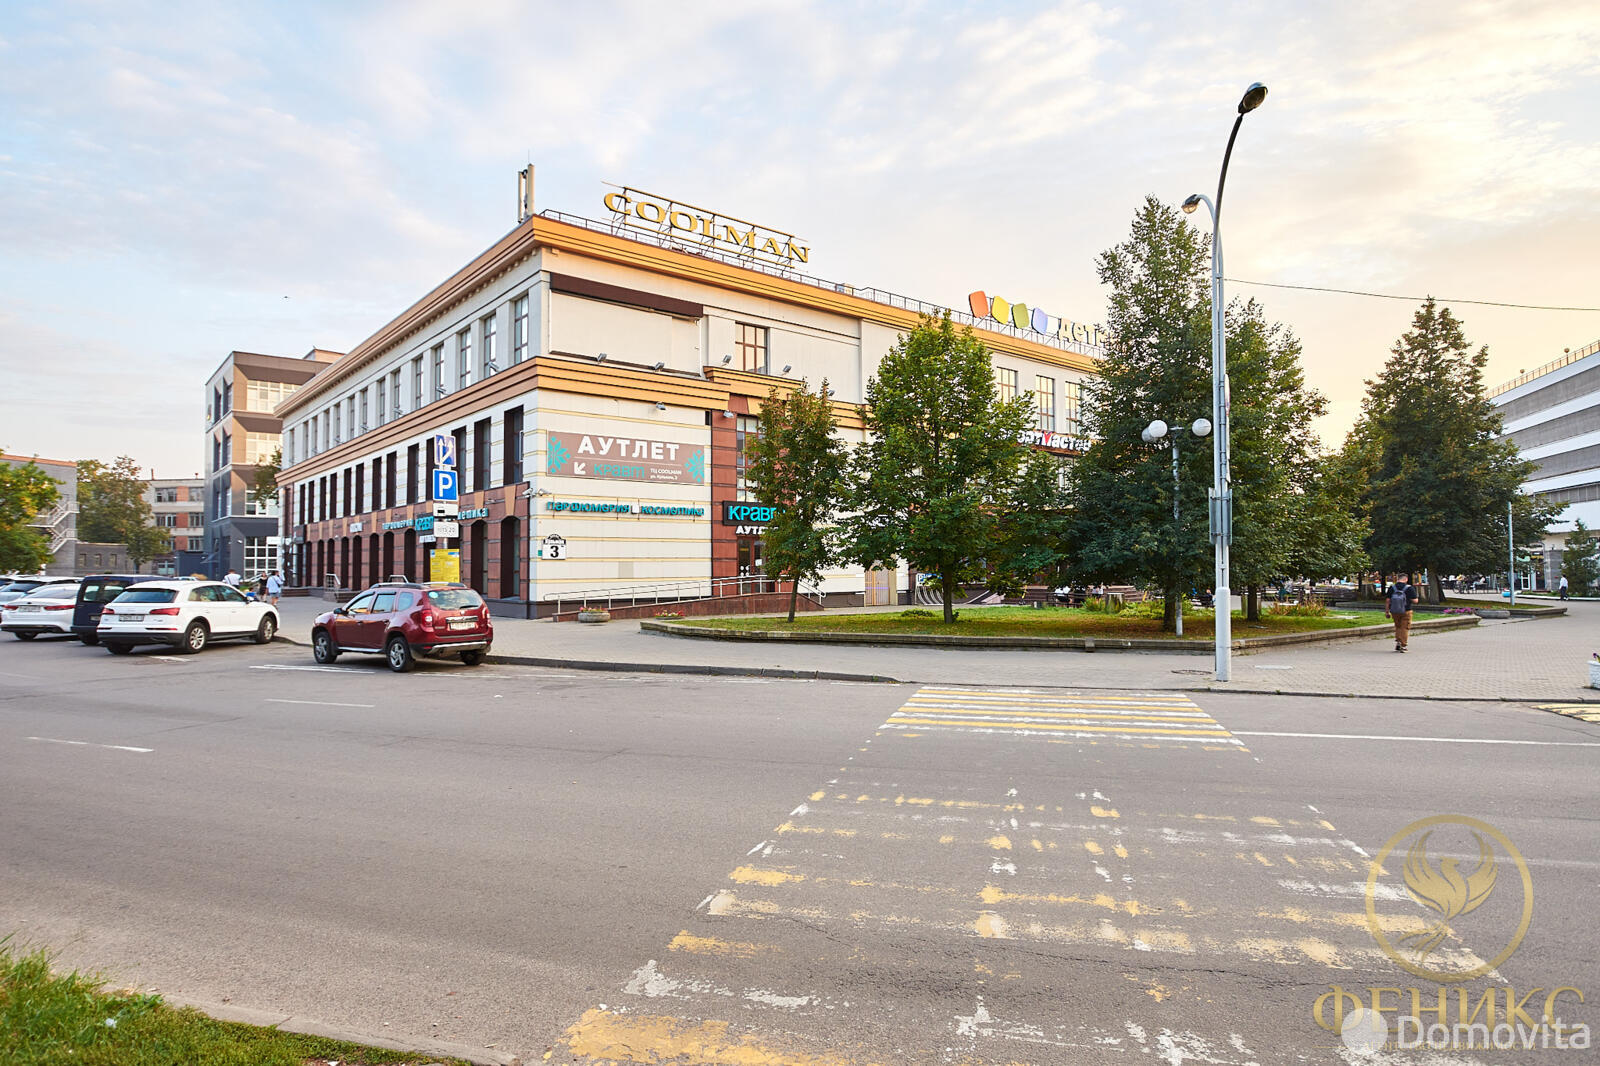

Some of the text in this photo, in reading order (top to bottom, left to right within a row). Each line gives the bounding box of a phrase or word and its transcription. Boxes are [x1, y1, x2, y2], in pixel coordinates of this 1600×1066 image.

[603, 192, 811, 264] COOLMAN
[577, 435, 680, 461] АУТЛЕТ
[438, 473, 453, 497] P
[550, 545, 559, 559] 3
